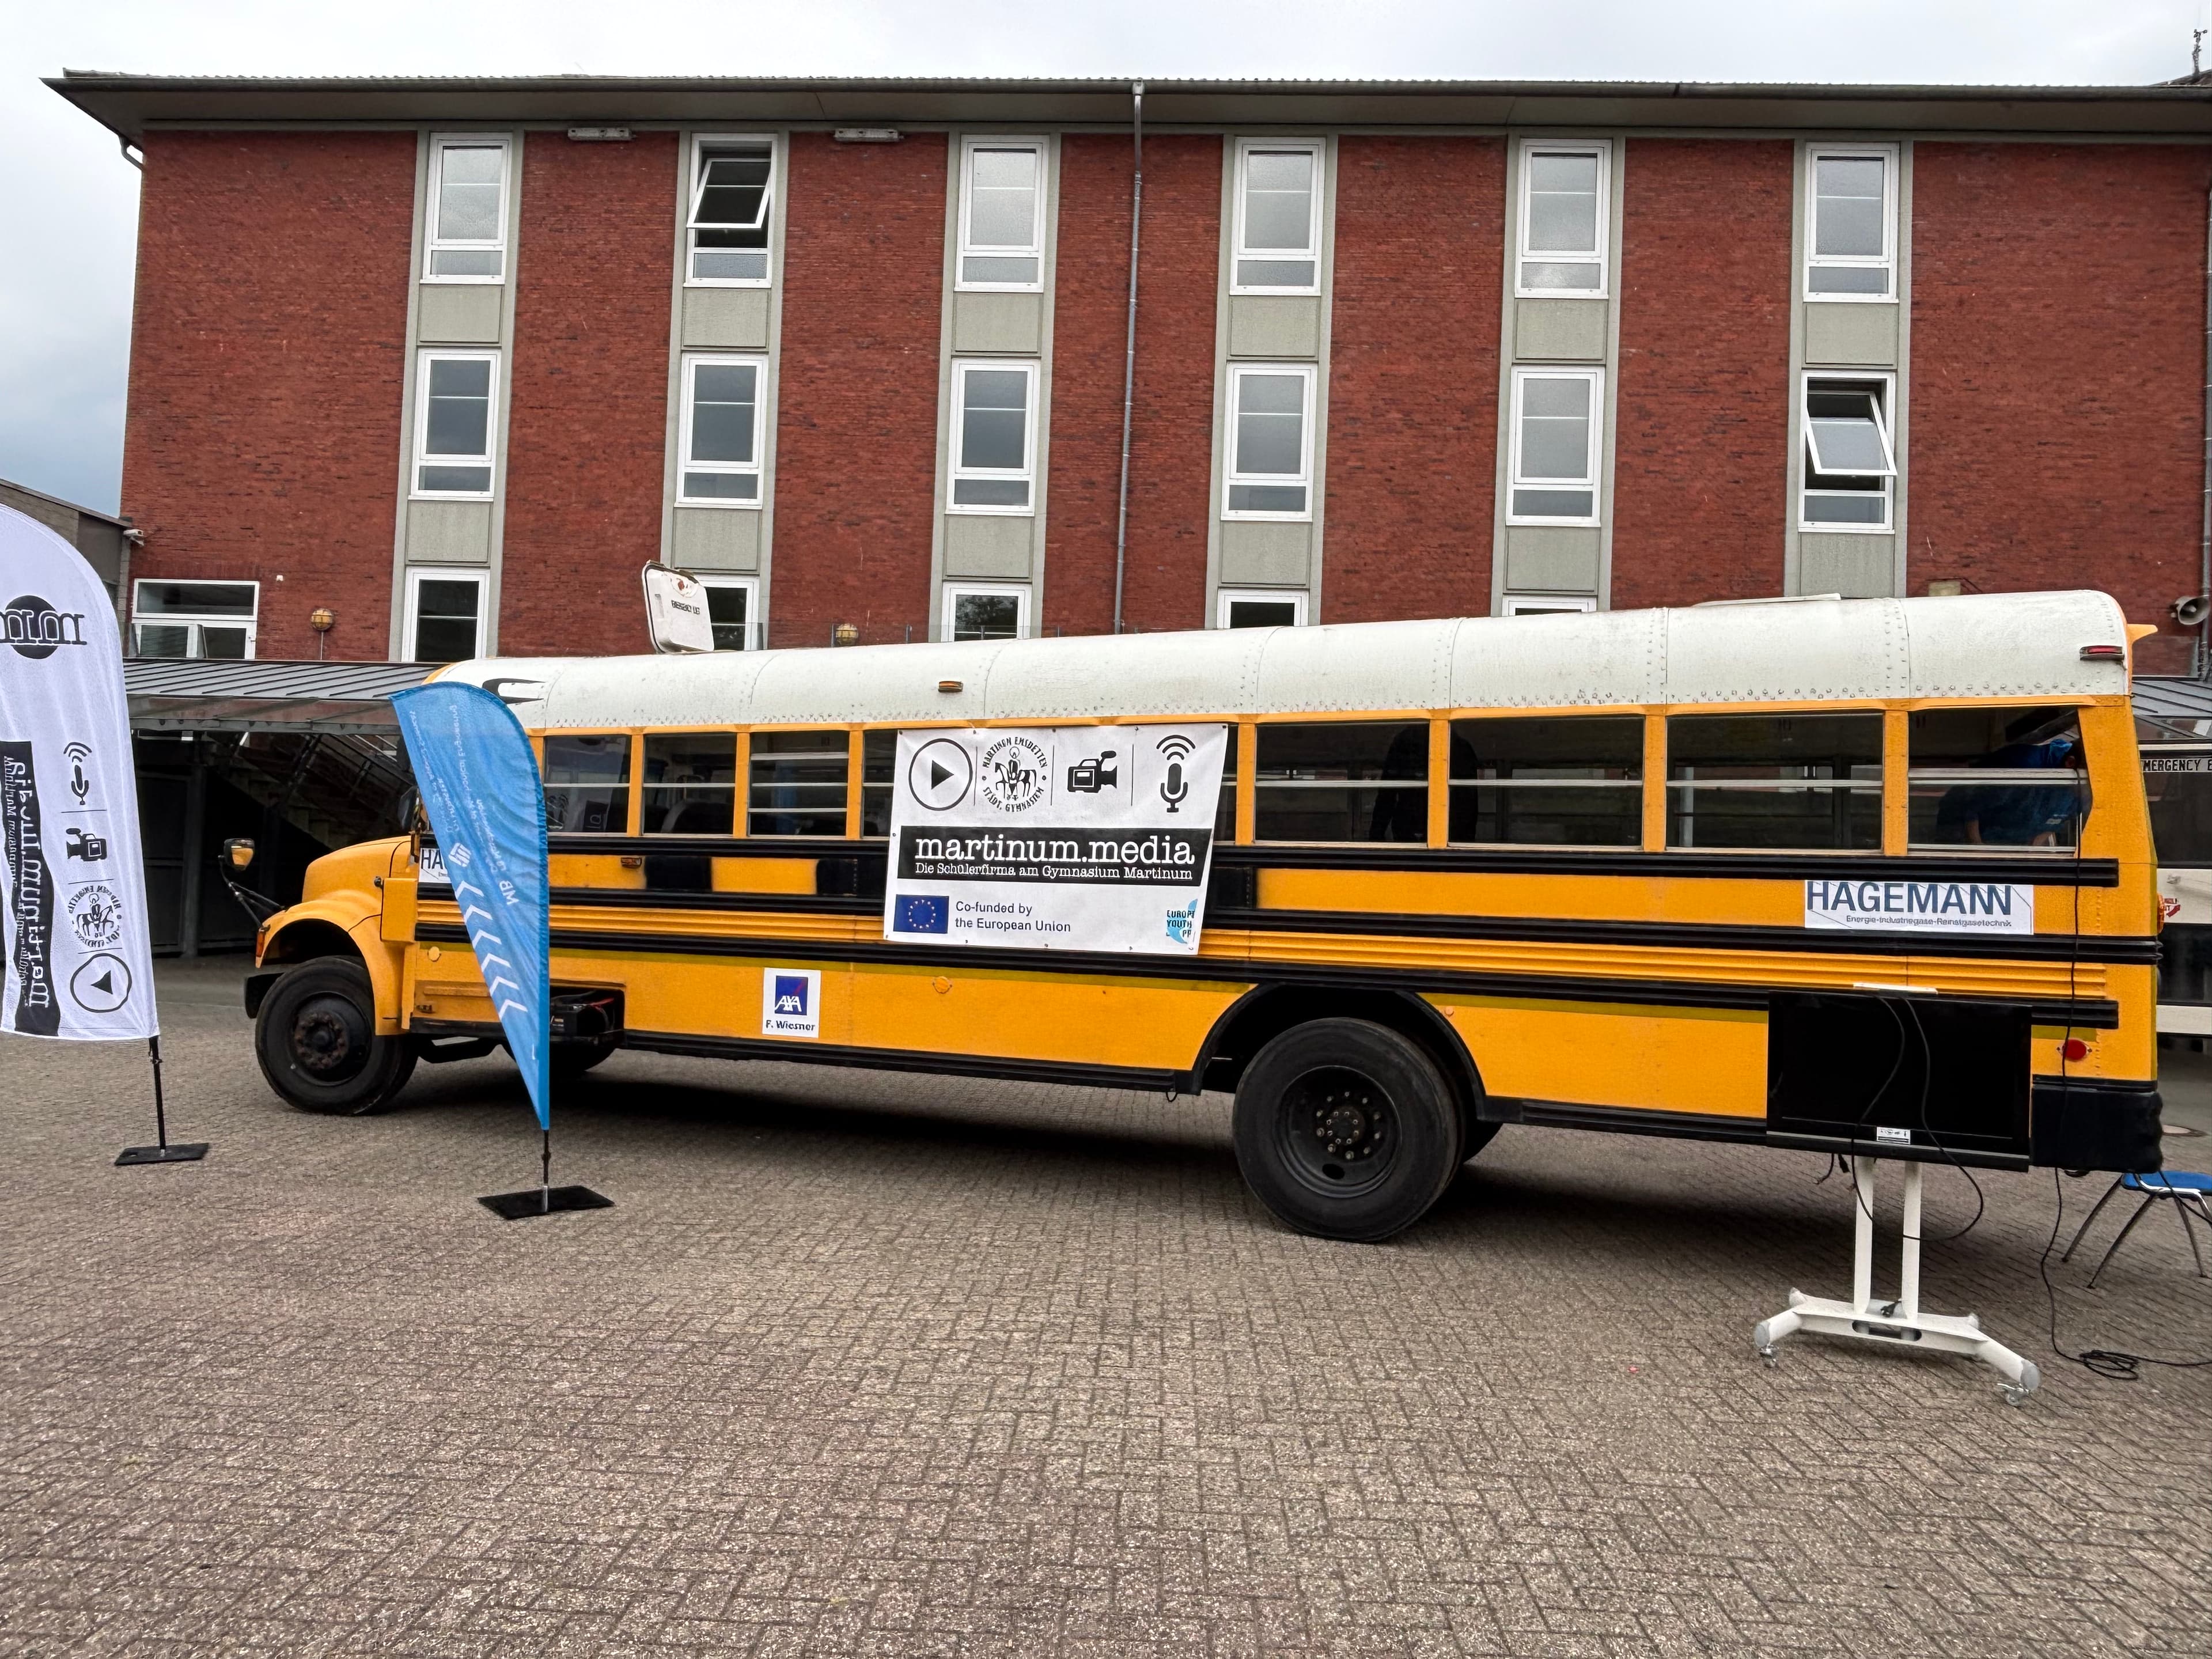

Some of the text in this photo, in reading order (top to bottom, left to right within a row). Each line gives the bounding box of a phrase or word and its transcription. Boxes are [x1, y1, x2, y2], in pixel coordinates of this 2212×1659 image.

[2143, 759, 2201, 771] MERGENCY
[915, 834, 1195, 864] martinum.media
[421, 849, 443, 869] HA
[915, 863, 1192, 880] Die Schülerfirma am Gymnasium Martinum
[1807, 881, 2011, 915] HAGEMANN
[956, 901, 1032, 916] Co-funded by
[955, 918, 1071, 932] the European Union
[1167, 920, 1192, 929] YOUTH
[775, 995, 802, 1012] AXA
[766, 1020, 773, 1028] F.
